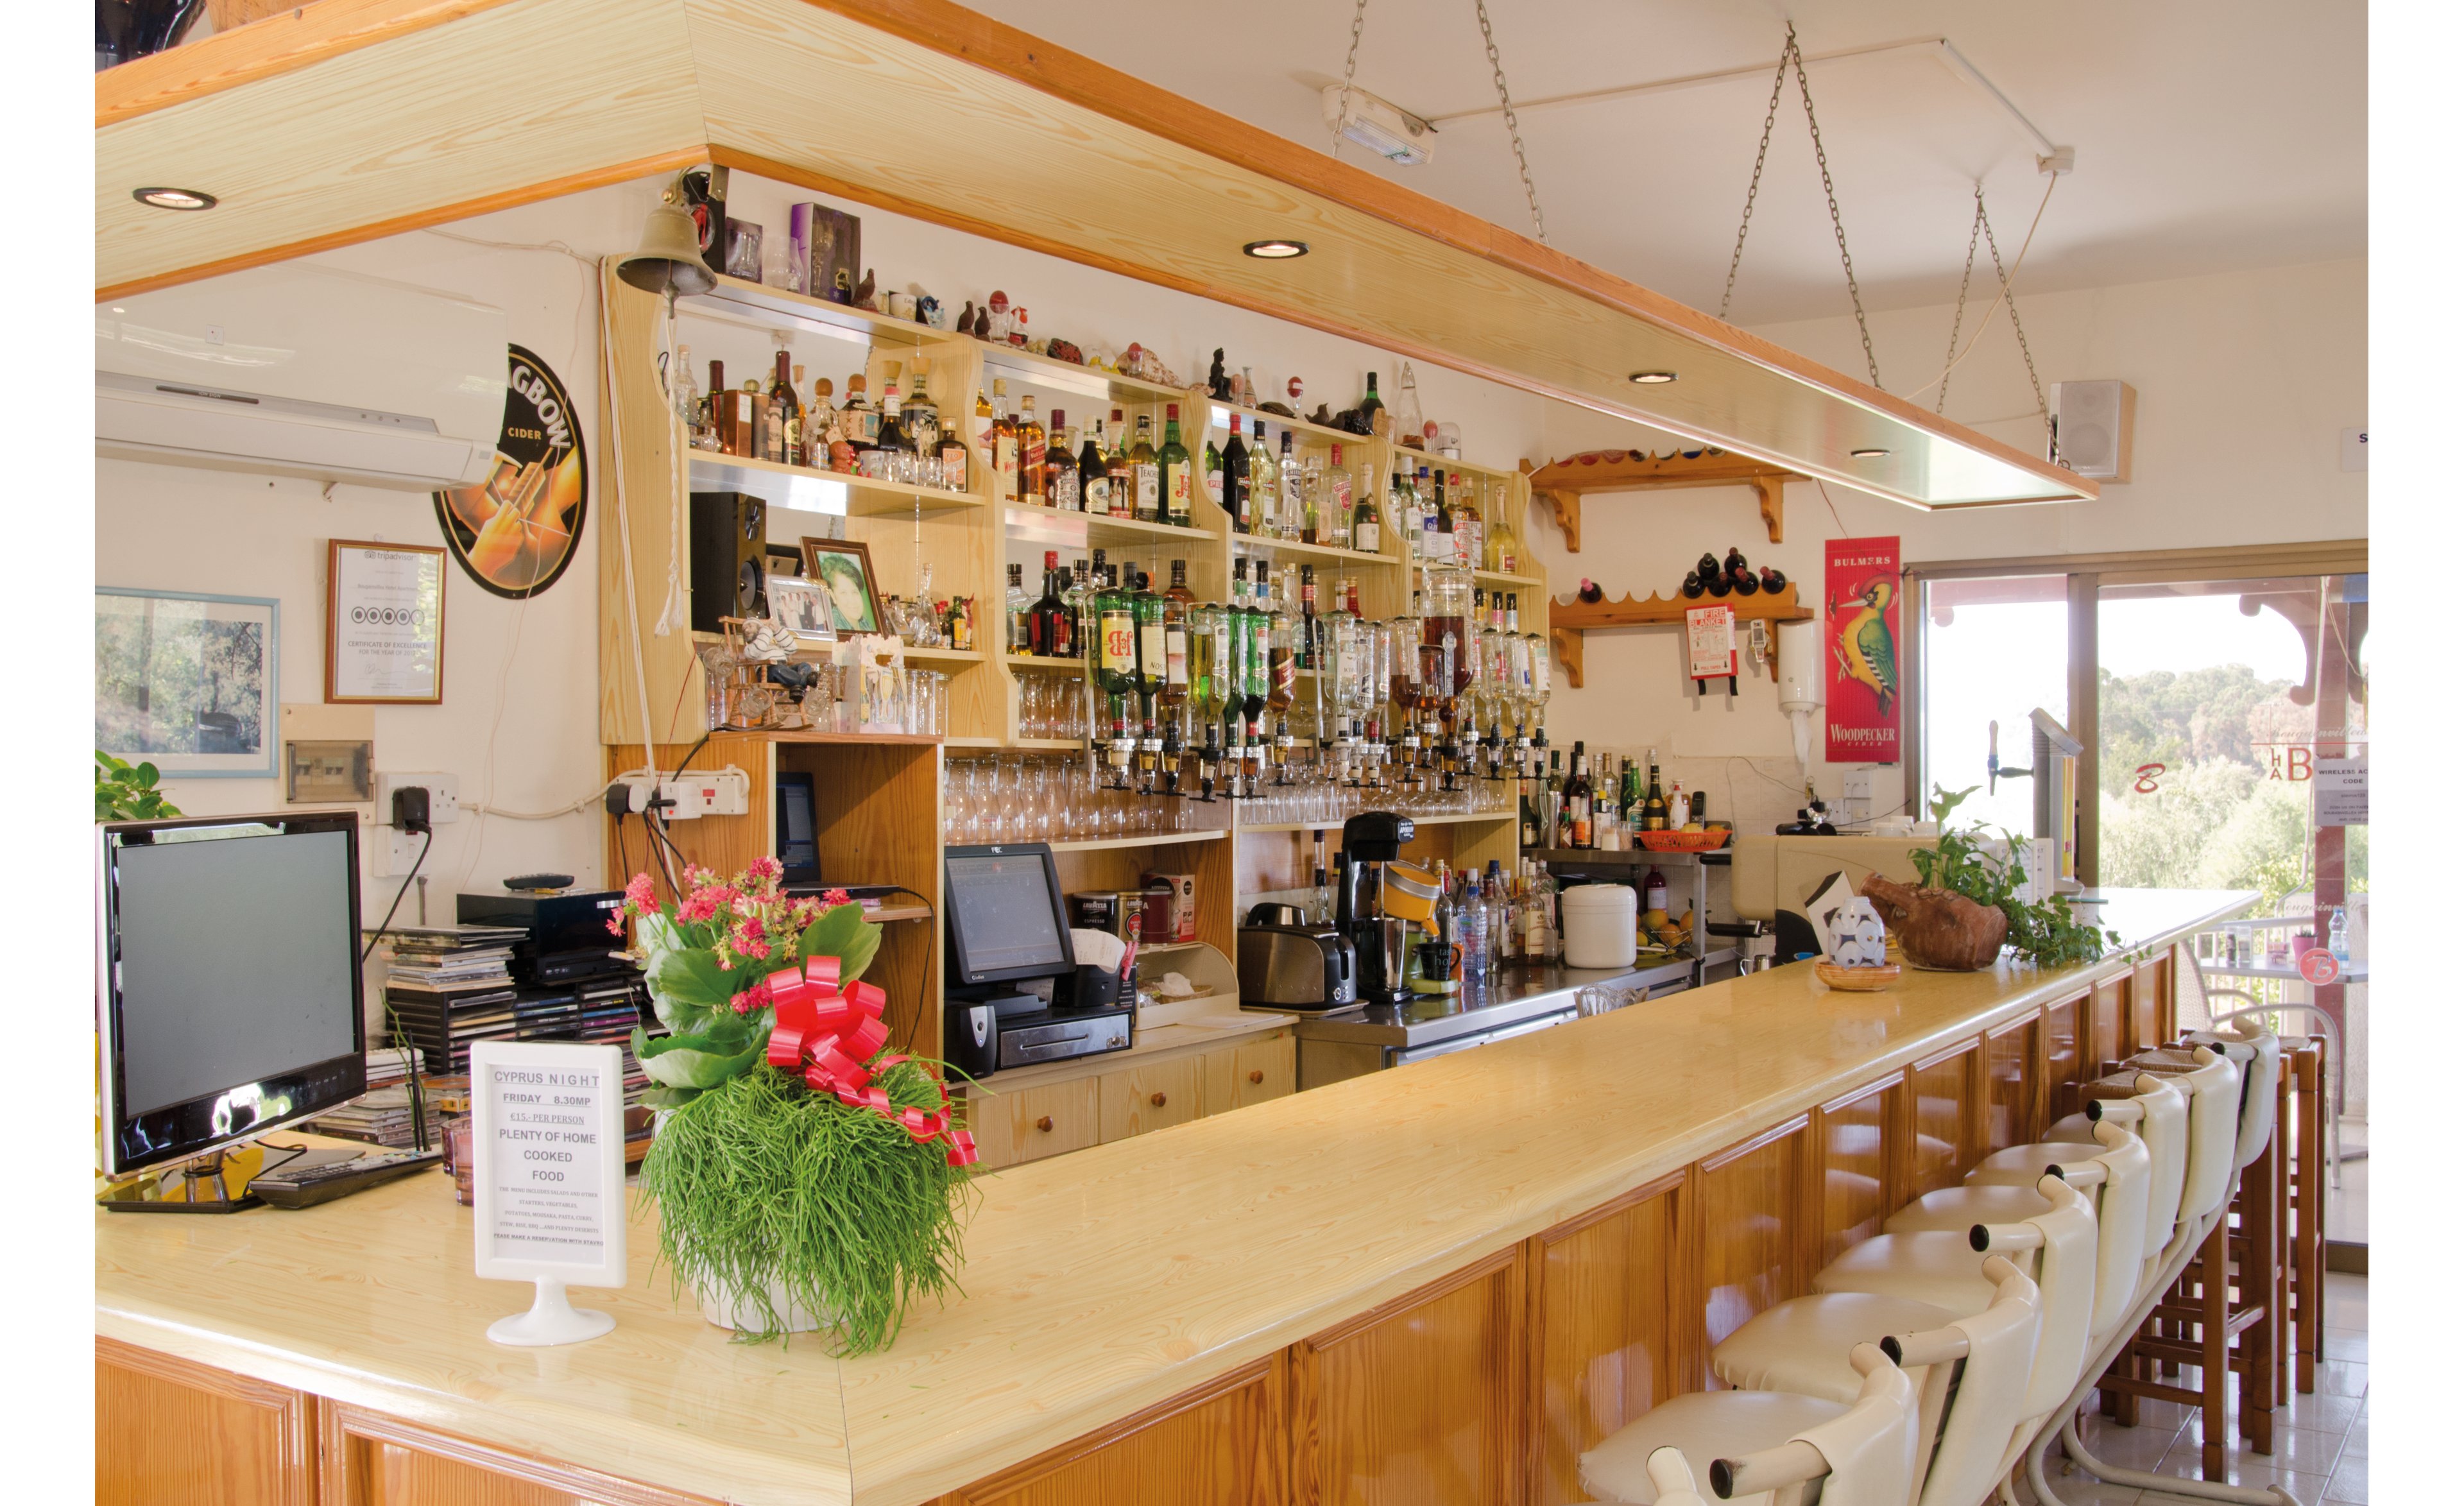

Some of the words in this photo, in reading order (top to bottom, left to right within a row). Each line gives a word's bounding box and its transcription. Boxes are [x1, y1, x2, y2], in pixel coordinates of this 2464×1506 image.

[508, 427, 541, 440] CIDER
[377, 552, 414, 561] tripadvisor
[1834, 556, 1891, 567] BULMERS
[1704, 608, 1725, 618] FIRE
[1689, 618, 1726, 628] BLANKET
[1830, 724, 1895, 743] WOODPECKER
[1082, 900, 1107, 909] LAVAZZA
[494, 1071, 543, 1083] CYPRUS
[503, 1093, 541, 1103] FRIDAY
[554, 1095, 591, 1106] 8.30MP
[533, 1113, 549, 1123] PER
[552, 1115, 585, 1125] PERSON
[499, 1129, 542, 1140] PLENTY
[545, 1131, 560, 1142] OF
[563, 1132, 597, 1144] HOME
[524, 1150, 572, 1162] COOKED
[533, 1170, 565, 1181] FOOD
